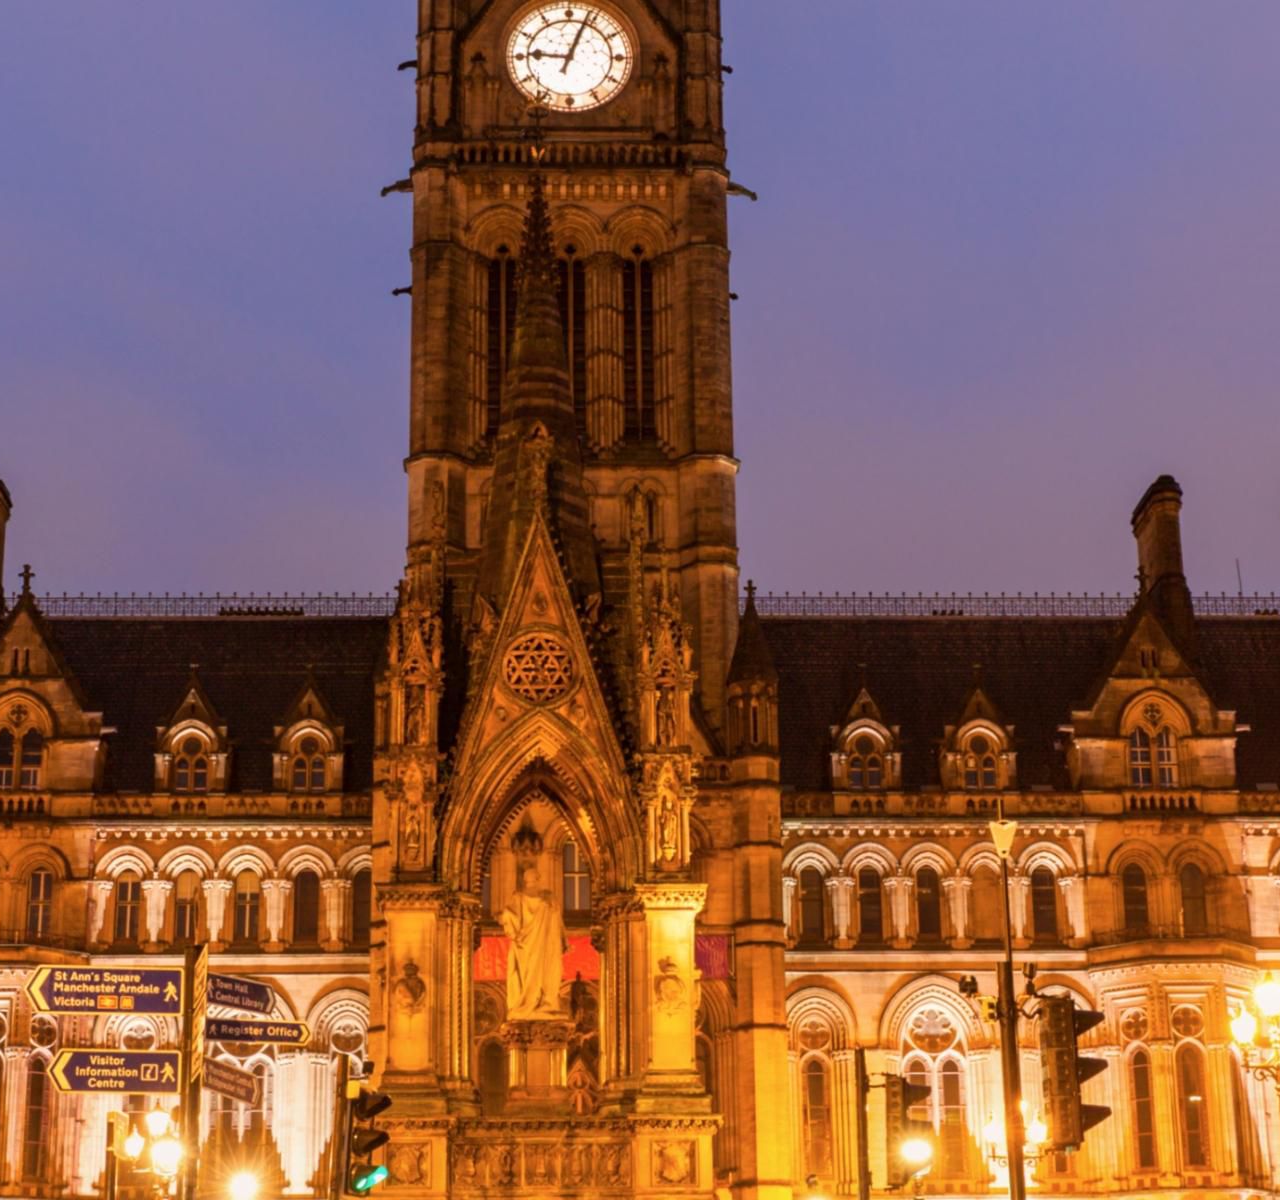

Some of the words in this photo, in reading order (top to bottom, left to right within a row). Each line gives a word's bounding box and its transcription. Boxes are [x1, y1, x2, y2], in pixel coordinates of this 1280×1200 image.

[55, 971, 67, 981] St
[70, 971, 99, 982] Ann's
[103, 972, 141, 983] Square
[53, 982, 116, 993] Manchester
[119, 984, 160, 994] Arndale
[53, 996, 95, 1007] Victoria
[241, 996, 265, 1010] Library
[221, 1025, 264, 1037] Register
[267, 1026, 298, 1037] Office
[89, 1055, 125, 1065] Visitor
[75, 1066, 138, 1077] Information
[87, 1078, 125, 1088] Centre
